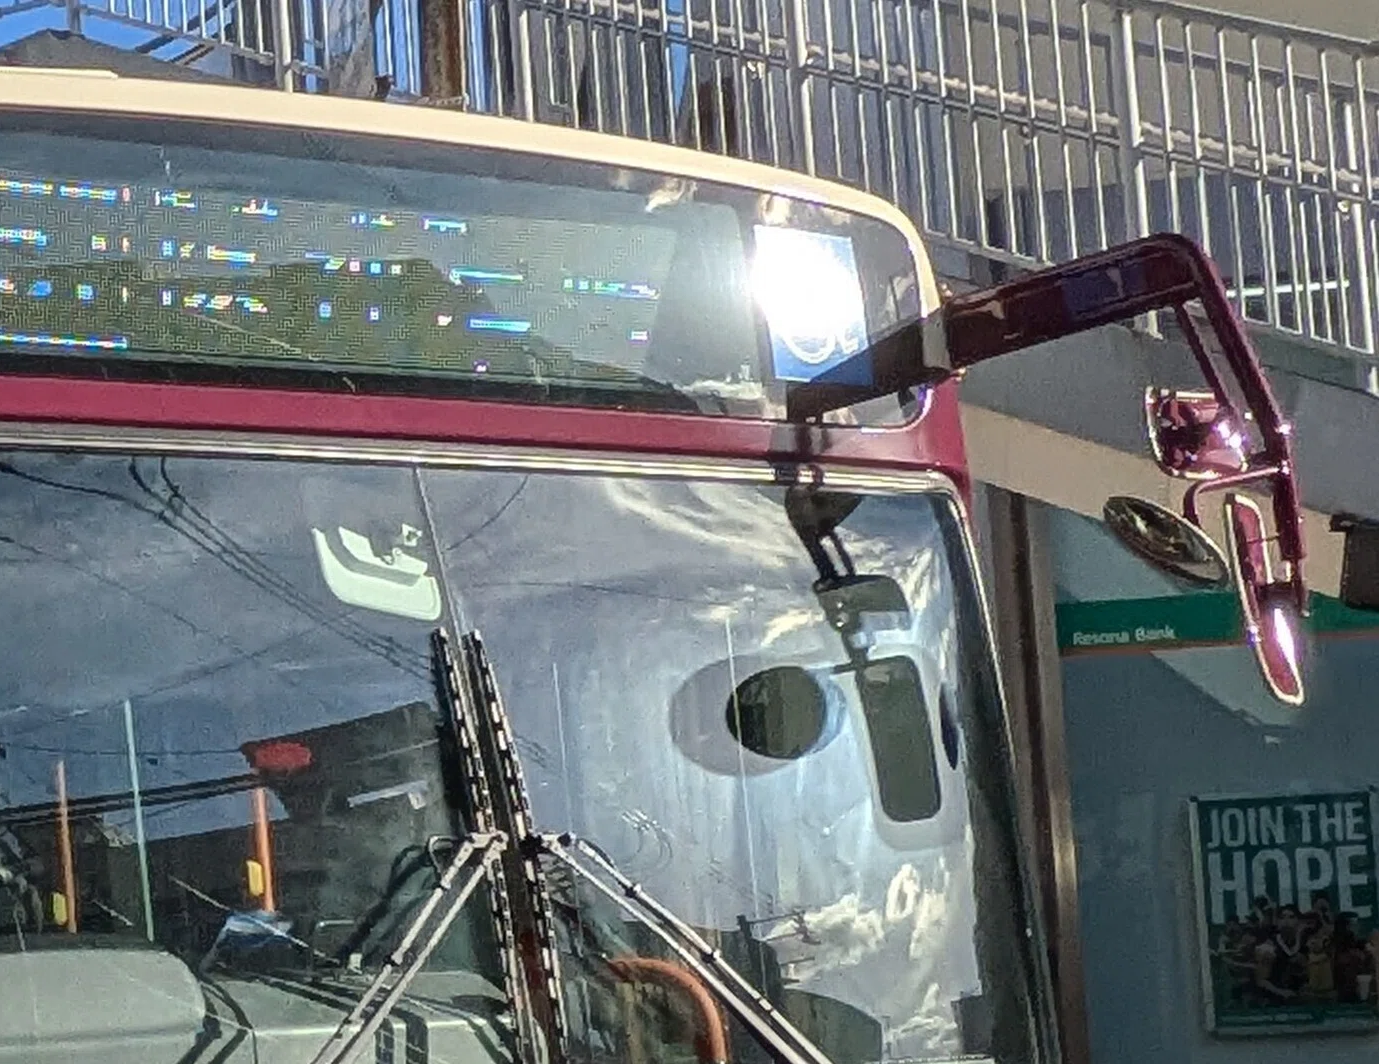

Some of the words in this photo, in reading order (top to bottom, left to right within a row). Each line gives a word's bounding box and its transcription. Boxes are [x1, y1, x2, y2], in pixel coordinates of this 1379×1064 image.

[1207, 806, 1286, 849] JOIN
[1293, 801, 1368, 844] THE
[1207, 844, 1372, 925] HOPE
